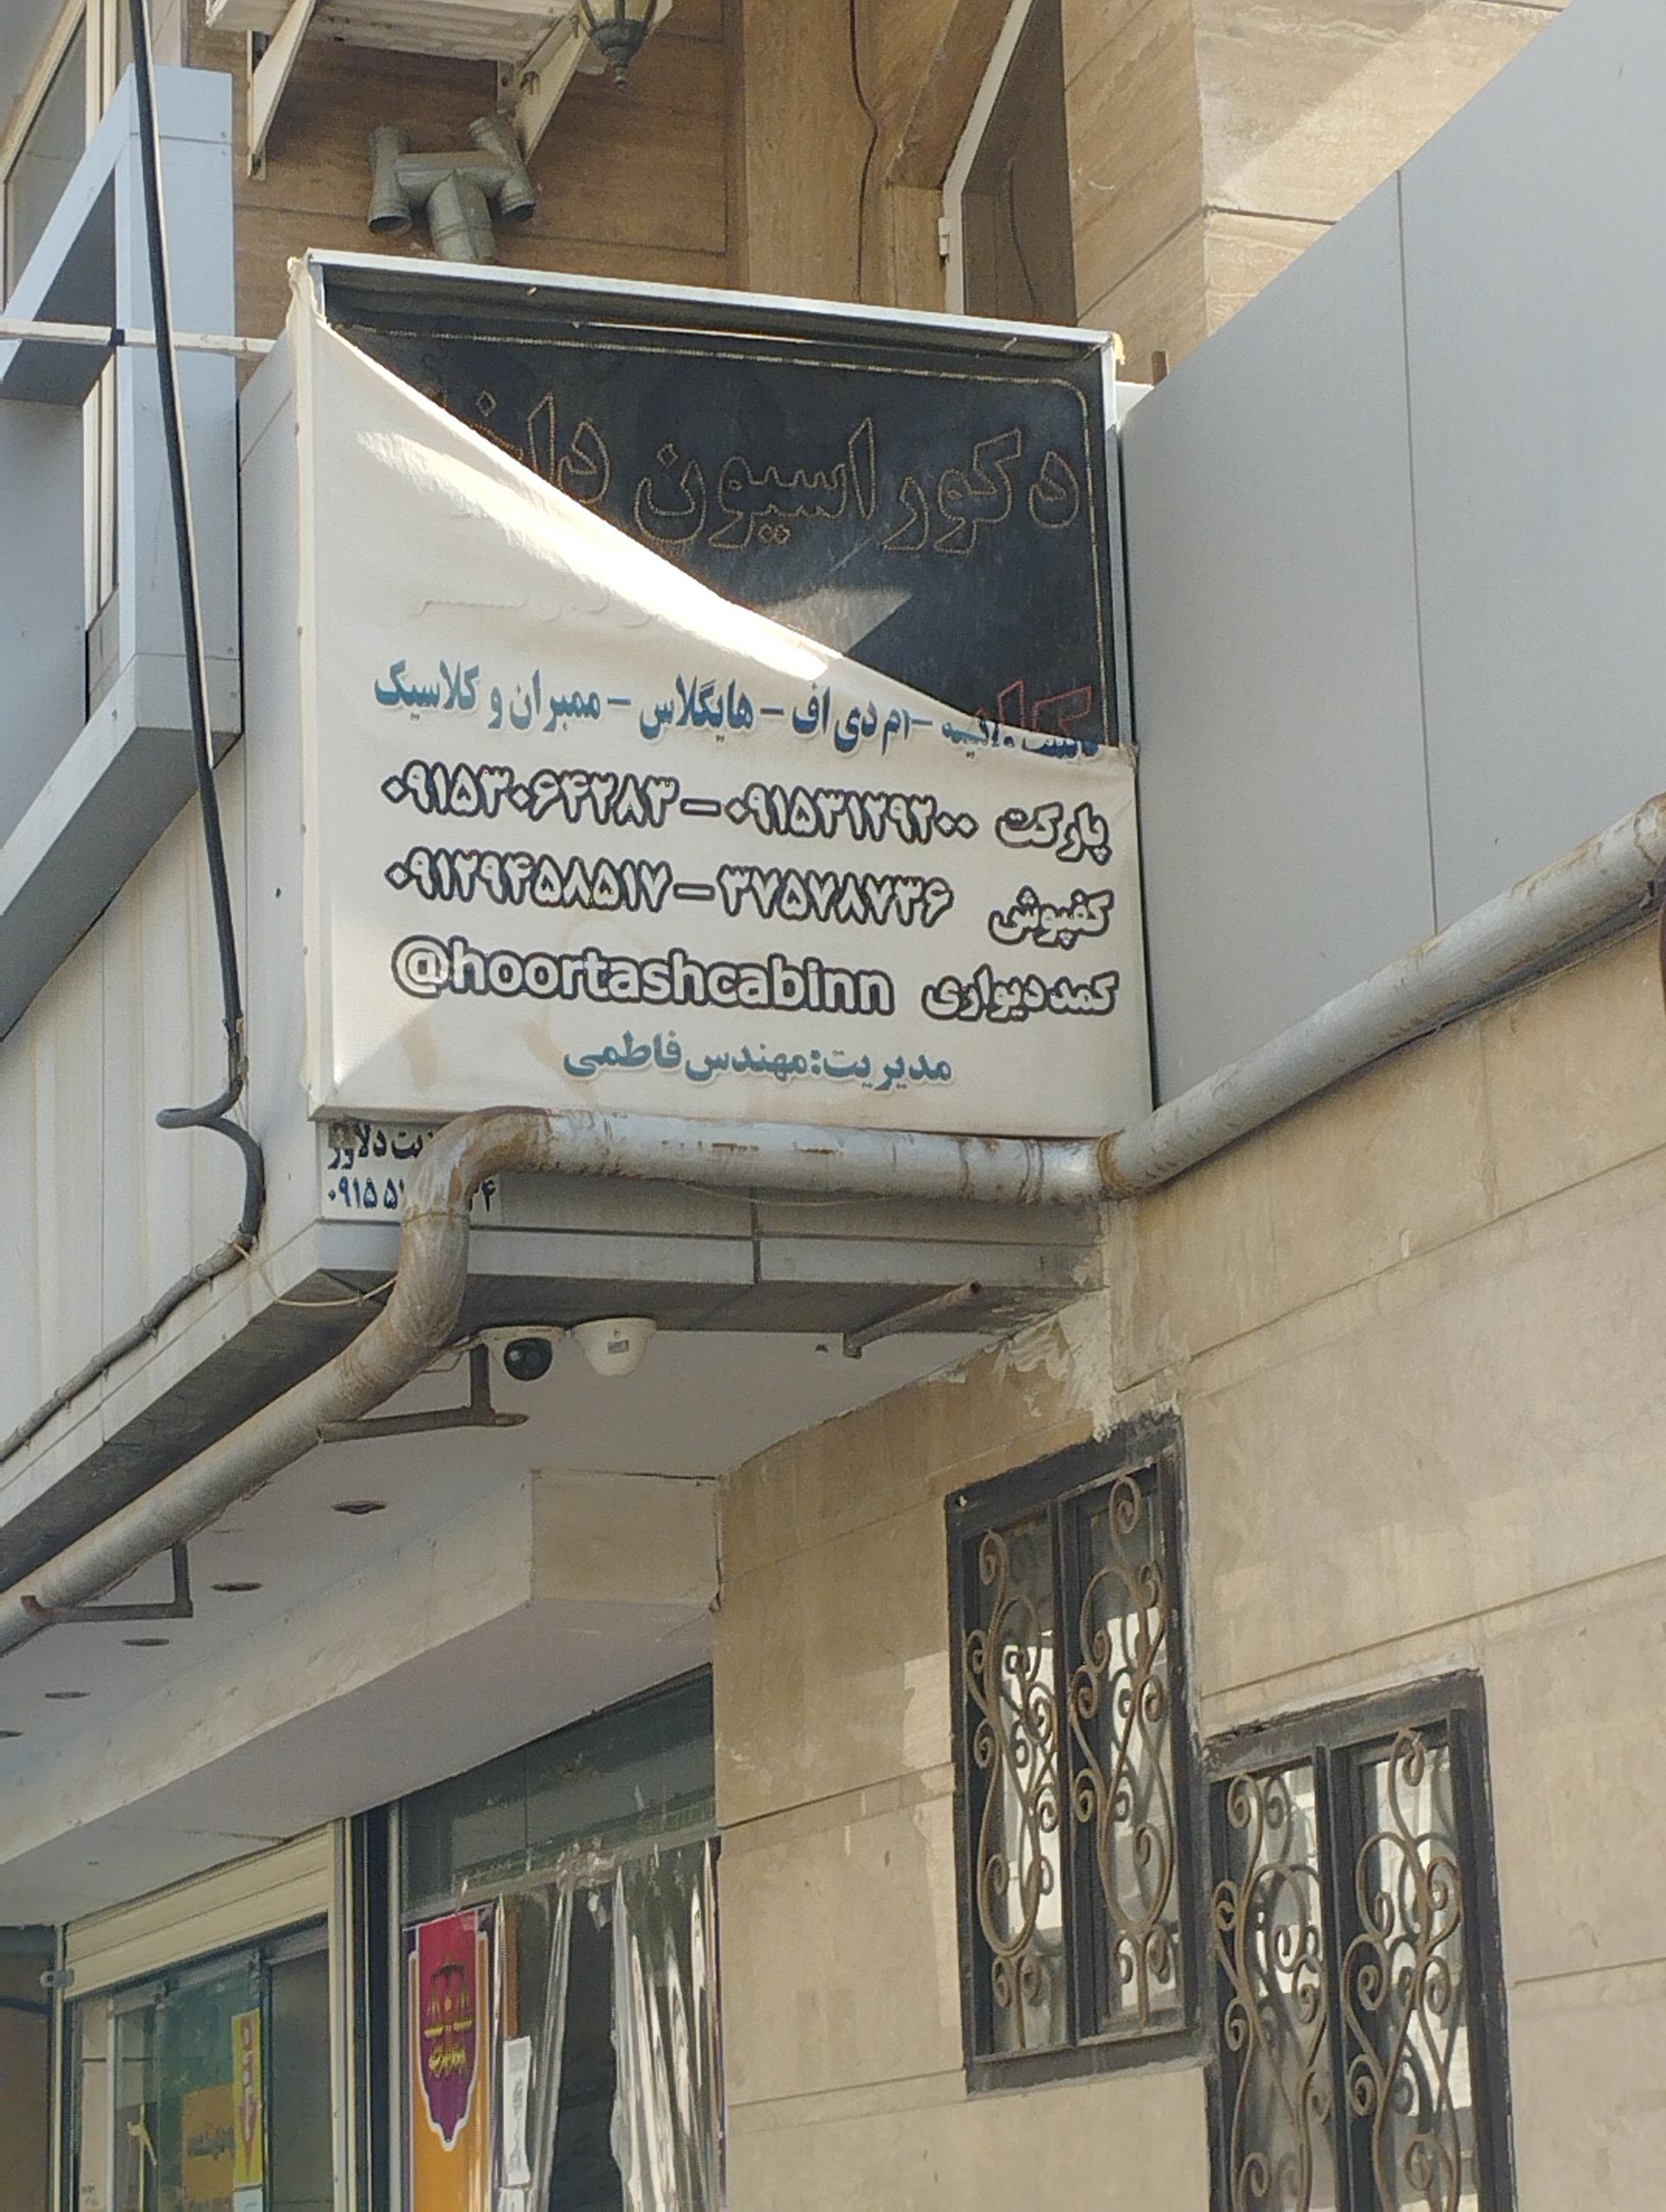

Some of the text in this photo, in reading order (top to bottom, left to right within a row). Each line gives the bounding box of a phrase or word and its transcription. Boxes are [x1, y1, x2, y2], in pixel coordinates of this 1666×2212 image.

[374, 658, 480, 722] کلاسیک
[995, 802, 1112, 866] پارکت
[988, 885, 1115, 950] کفپوش
[390, 933, 895, 1016] @hoortashcabinn
[564, 1031, 683, 1077] فاطمی
